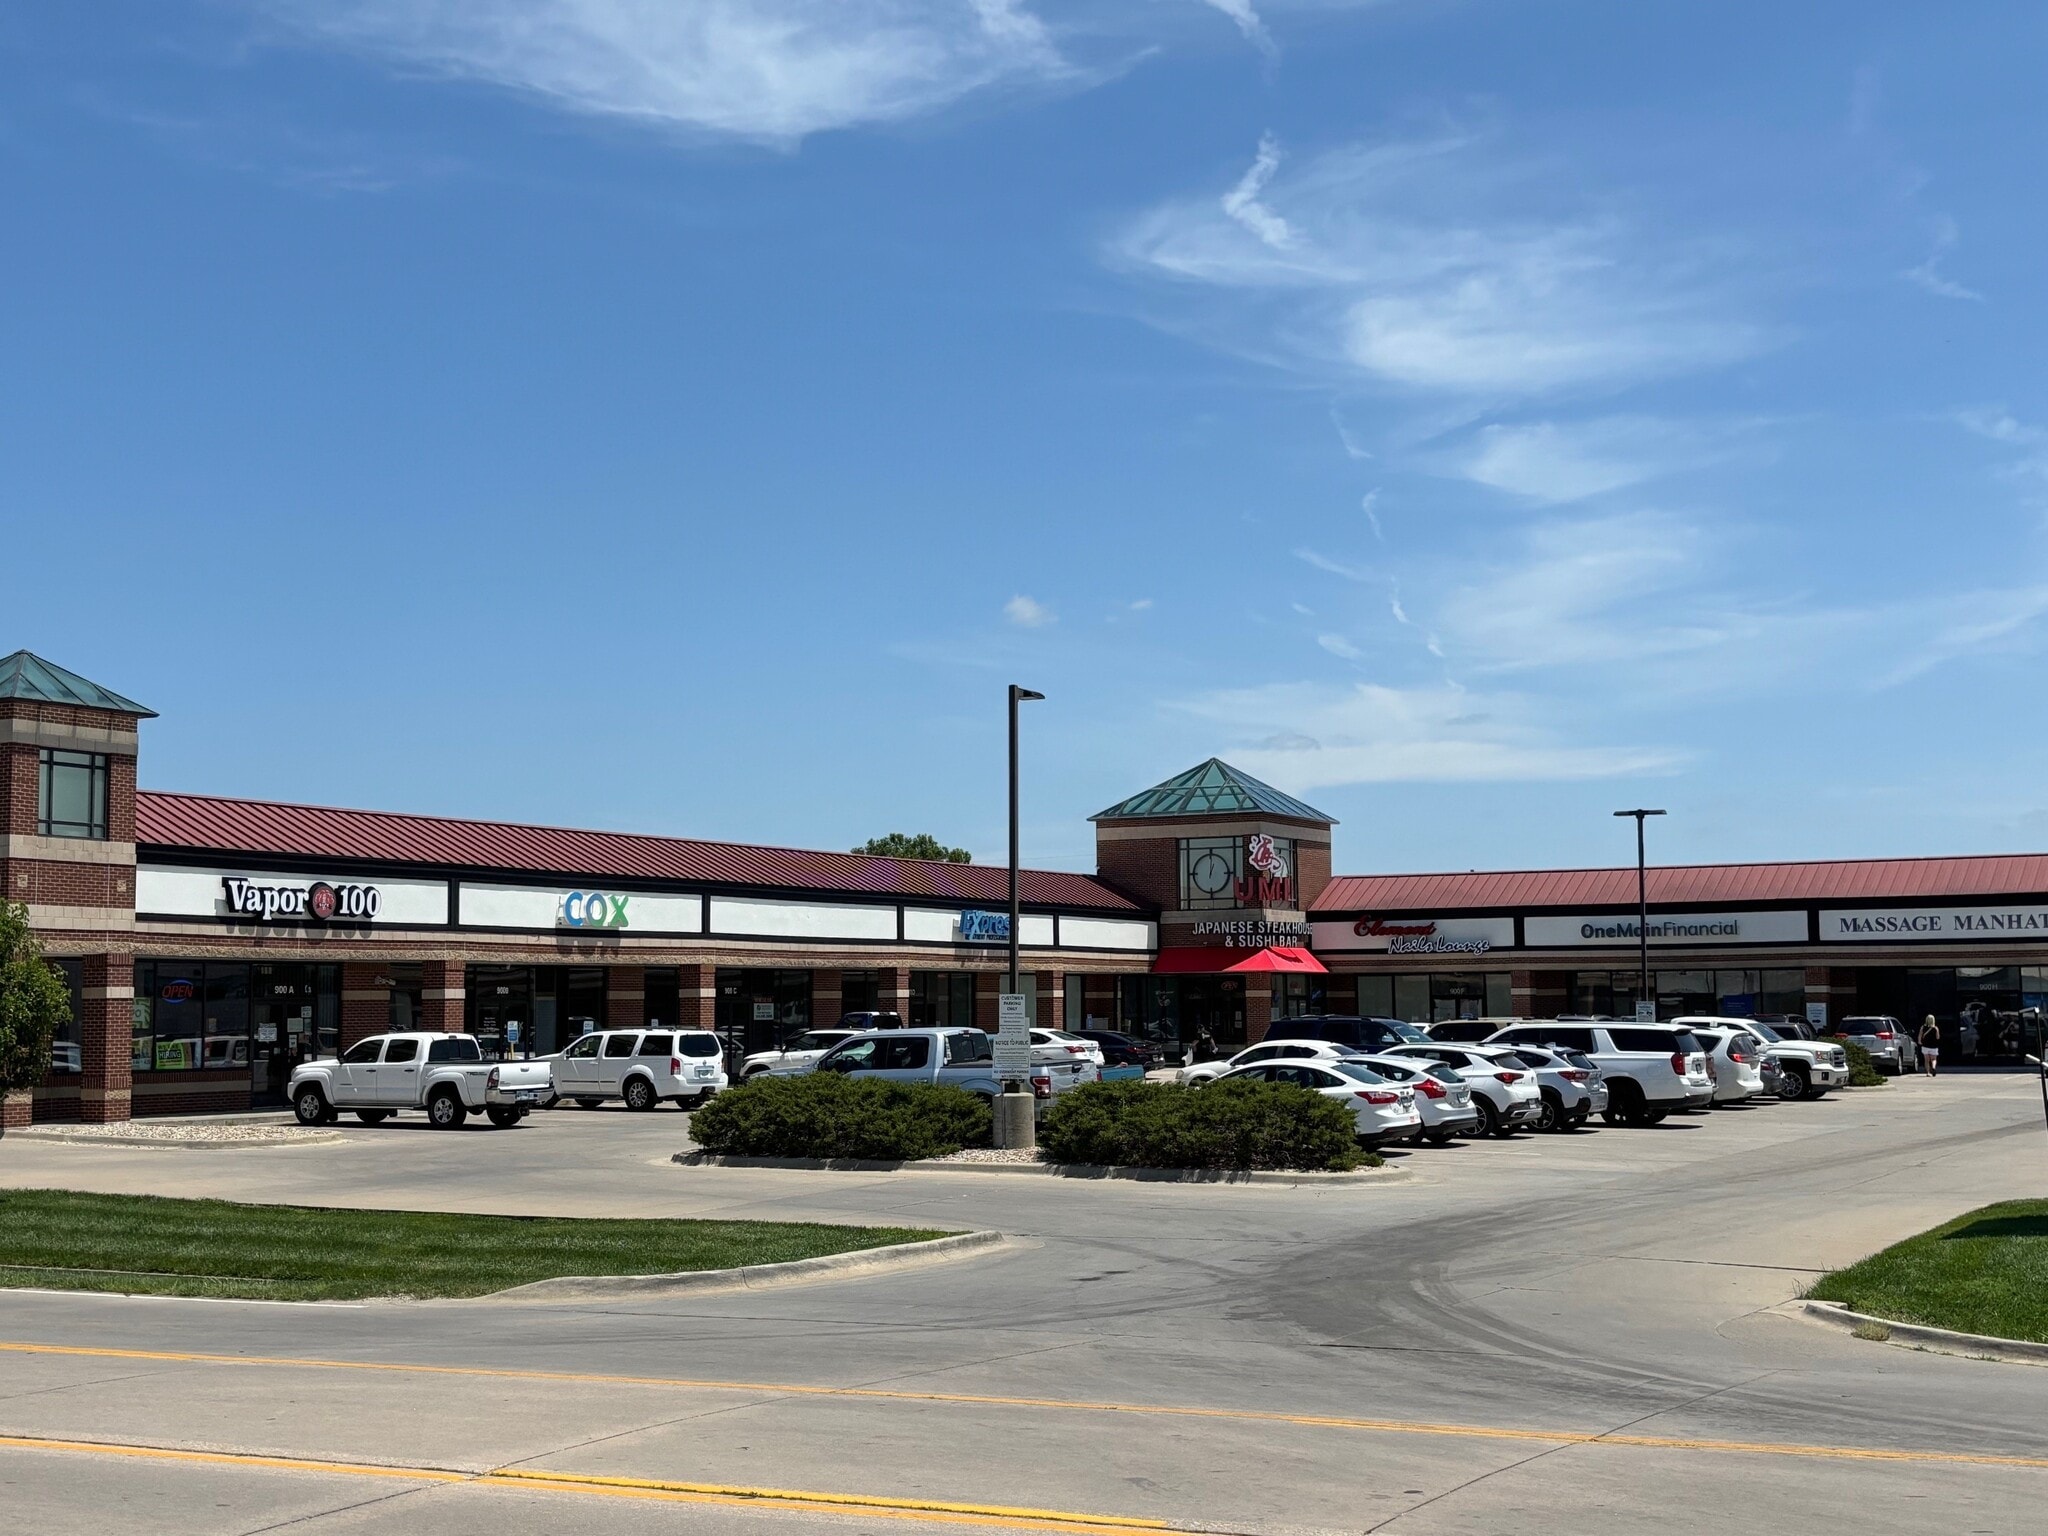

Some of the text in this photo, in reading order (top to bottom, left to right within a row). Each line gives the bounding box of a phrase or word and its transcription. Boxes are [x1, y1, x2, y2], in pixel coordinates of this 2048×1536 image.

[1233, 876, 1291, 901] UMI
[226, 880, 382, 921] Vapor 100
[564, 891, 630, 928] COX
[962, 910, 1010, 940] Expres
[1192, 921, 1313, 935] JAPANESE STEAKHOUSE
[1581, 919, 1738, 939] OneMainFinancial
[1839, 915, 1942, 933] MASSAGE
[1225, 935, 1298, 948] & SUSHI BAR
[1388, 935, 1490, 955] Nails Lounge
[162, 985, 194, 998] OPEN
[274, 986, 294, 994] 900 A
